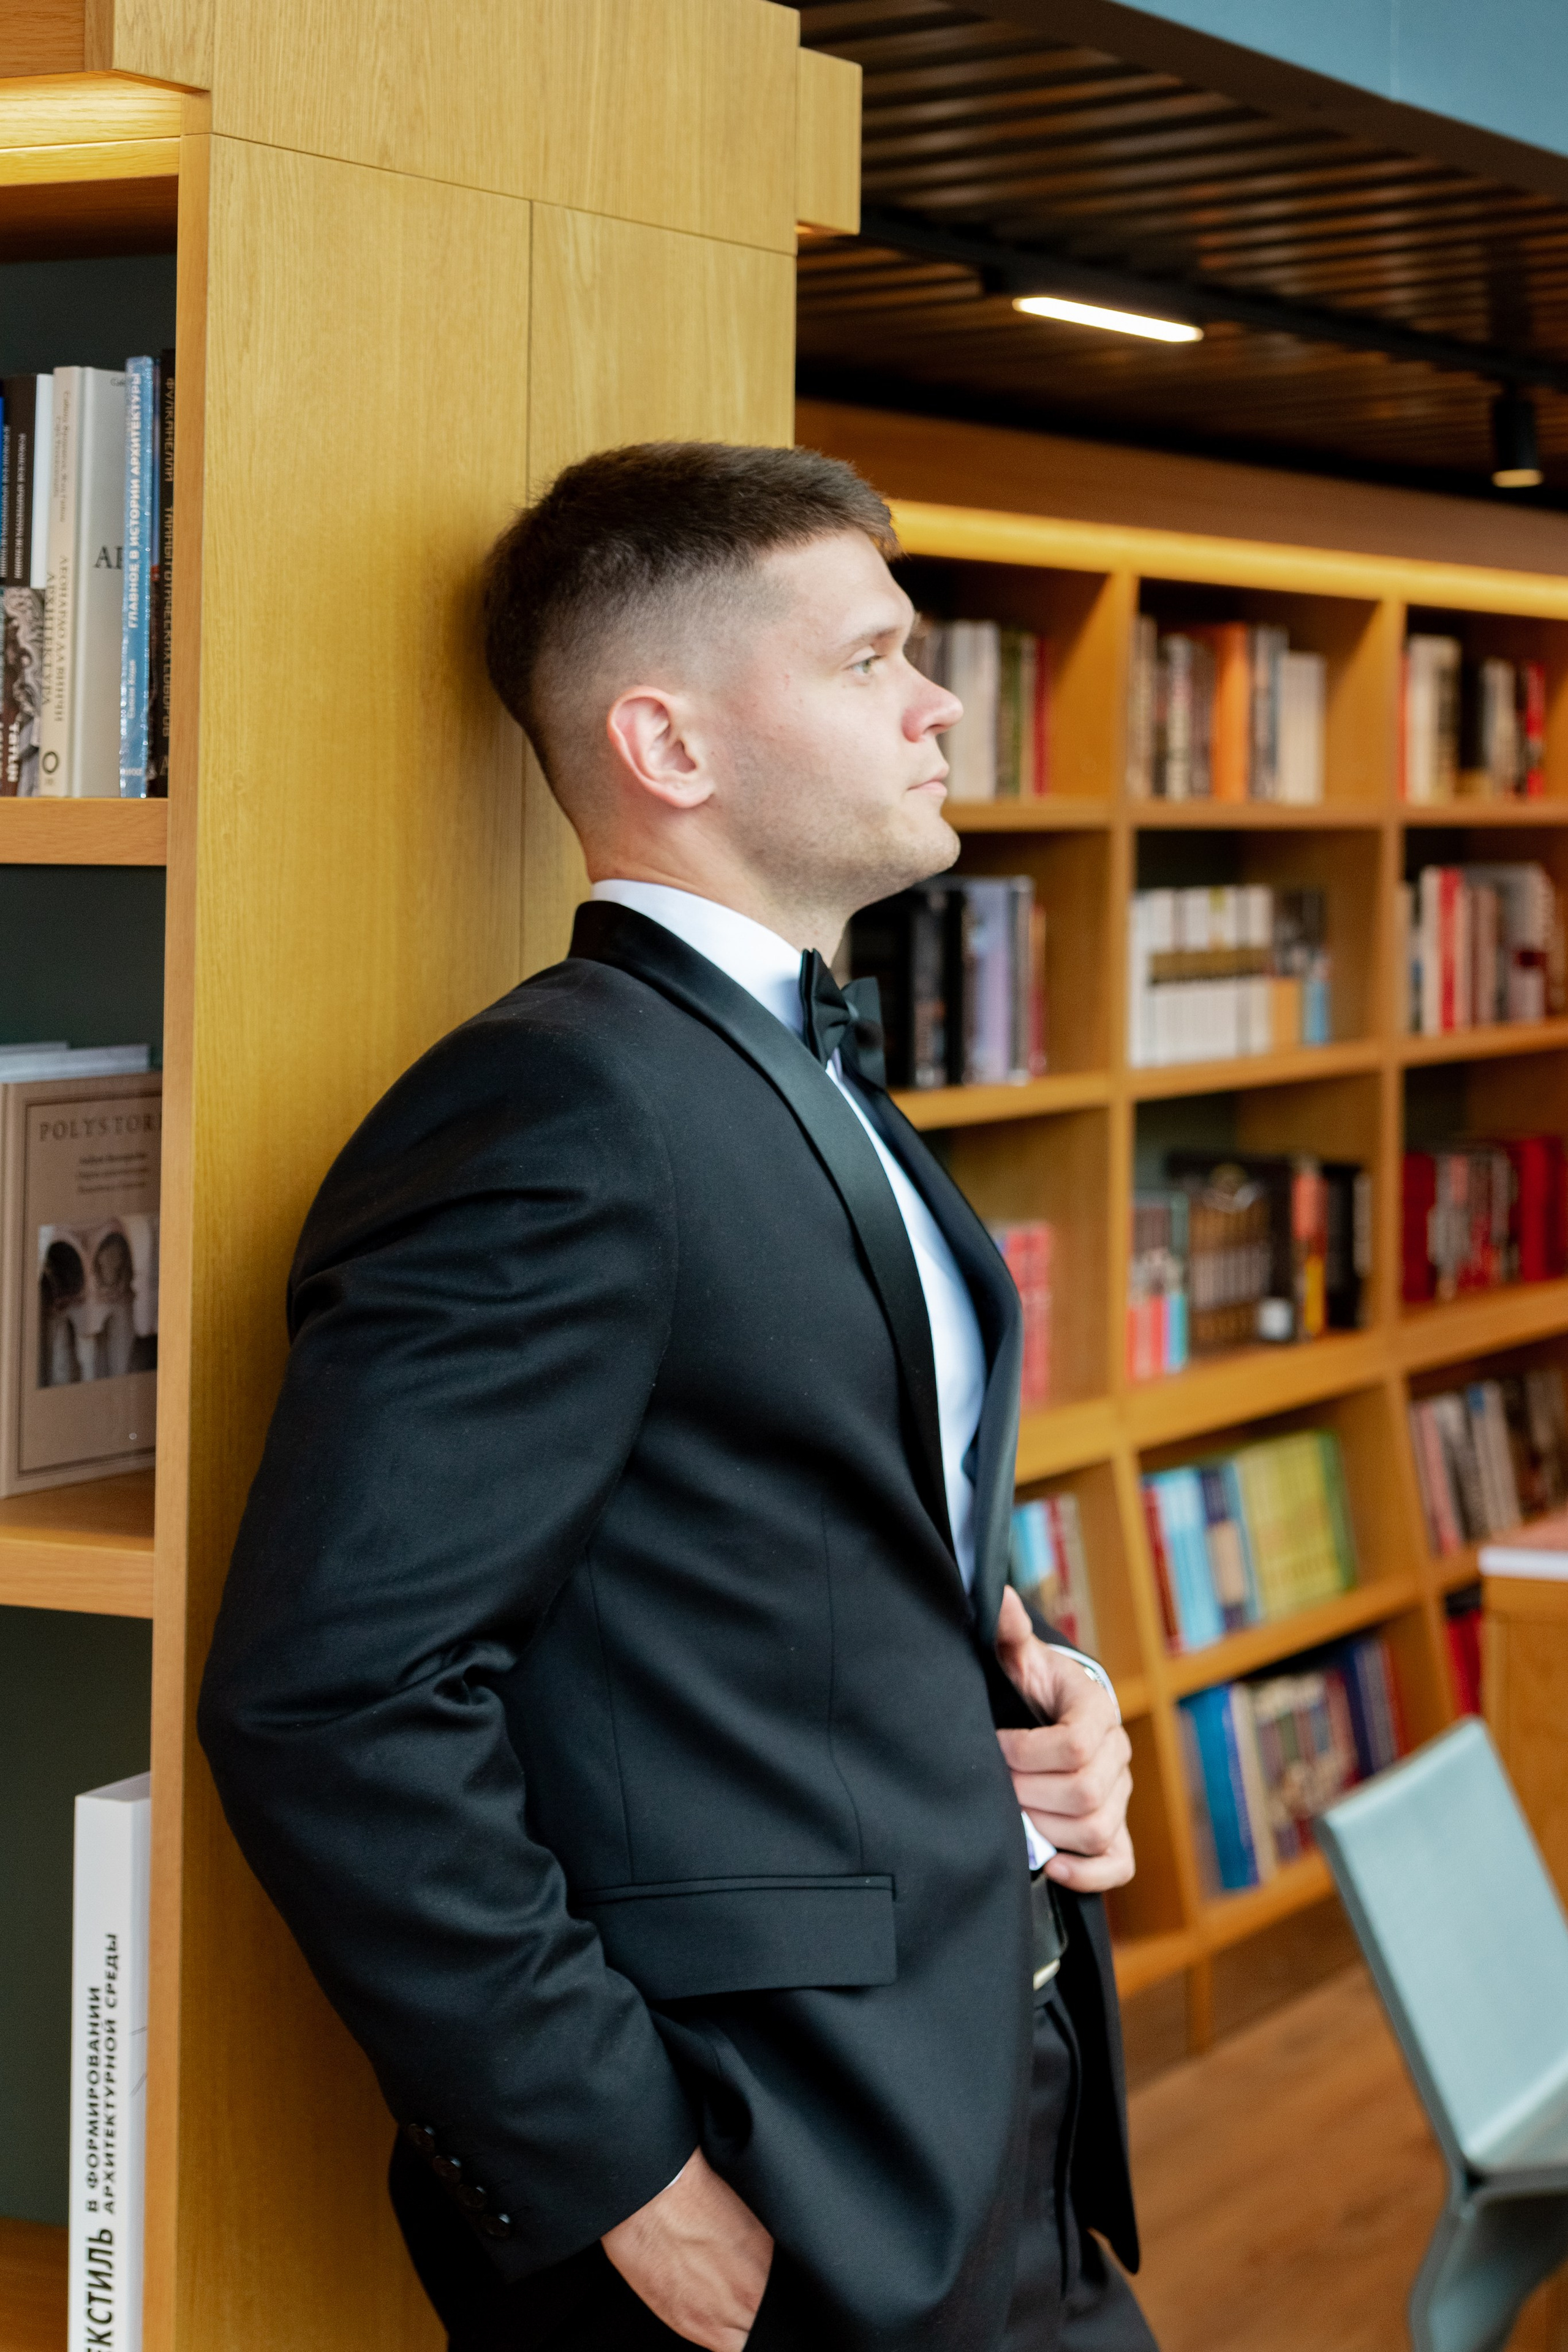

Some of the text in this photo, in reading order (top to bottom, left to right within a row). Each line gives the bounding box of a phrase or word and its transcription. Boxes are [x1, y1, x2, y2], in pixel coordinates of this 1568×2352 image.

[128, 373, 141, 628] ГЛАВНОЕ В ИСТОРИИ АРХИТЕКТУРЫ
[87, 1988, 100, 2212] В ФОРМИРОВАНИИ
[103, 1934, 119, 2214] АРХИТЕКТУРНОЙ СРЕДЫ
[87, 2228, 113, 2352] КСТИЛЬ
